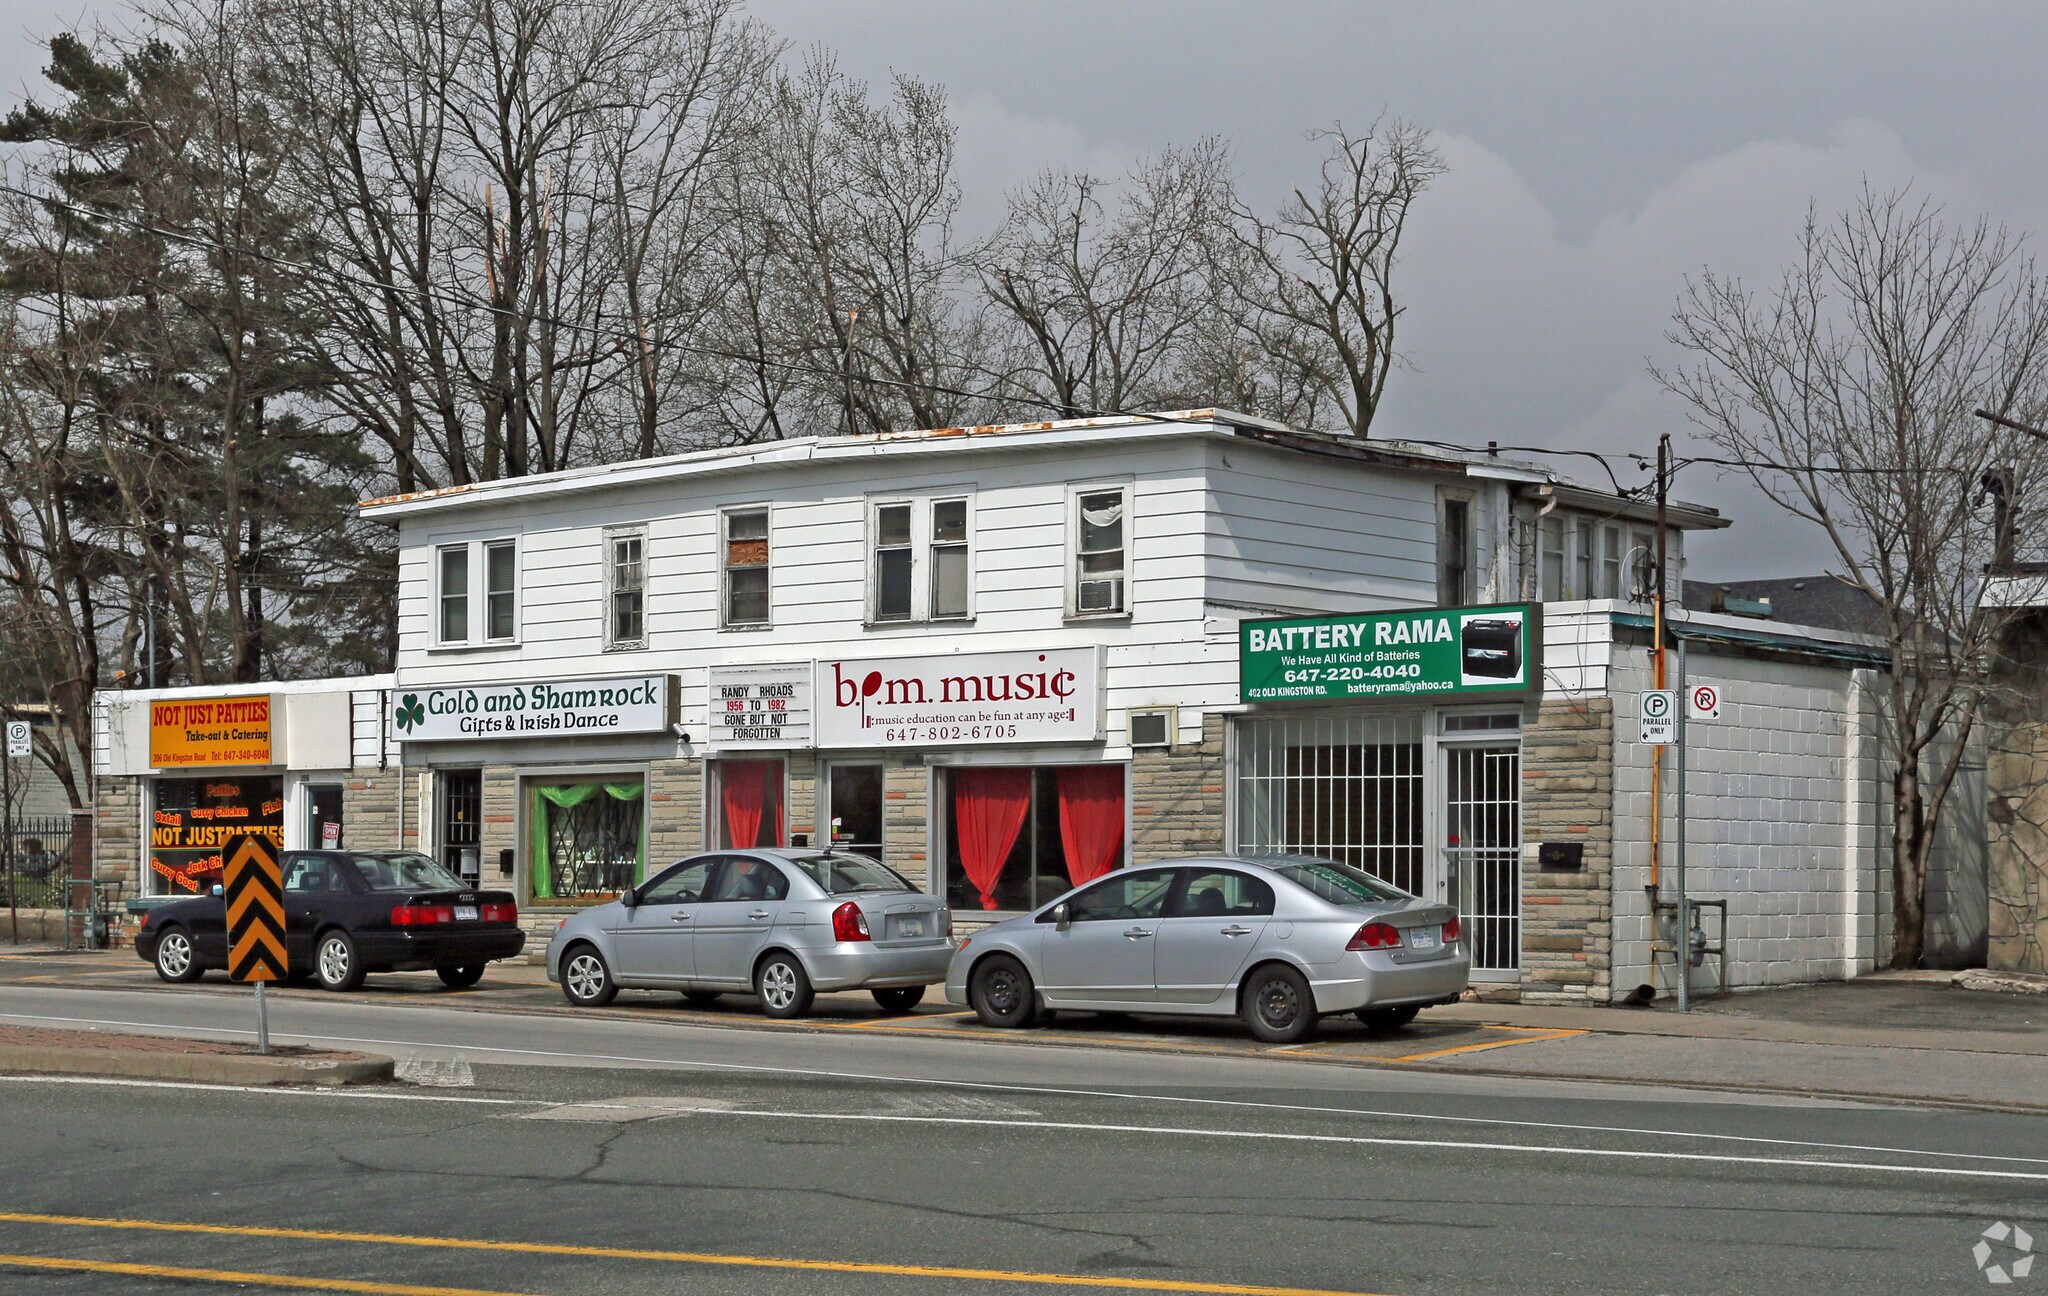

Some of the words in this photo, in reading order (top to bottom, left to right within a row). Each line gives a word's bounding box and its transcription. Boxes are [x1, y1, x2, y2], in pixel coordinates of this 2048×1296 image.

[1250, 623, 1366, 652] BATTERY
[1375, 618, 1453, 645] RAMA
[1281, 656, 1295, 665] We
[1298, 655, 1321, 665] Have
[1324, 654, 1336, 663] All
[1339, 652, 1361, 663] Kind
[1364, 651, 1374, 662] of
[1377, 650, 1420, 661] Batteries
[1284, 664, 1420, 683] 647-220-4040
[721, 686, 749, 698] RANDY
[760, 685, 794, 697] RHOADS
[1248, 688, 1261, 697] 402
[1262, 687, 1276, 697] OLD
[1277, 686, 1314, 696] KINGSTON
[1315, 685, 1328, 695] RD.
[1347, 680, 1454, 695] batteryrama@yahoo.ca
[428, 689, 479, 715] Gold
[484, 687, 526, 712] and
[726, 700, 744, 711] 1956
[750, 700, 760, 710] TO
[767, 699, 786, 710] 1982
[153, 705, 181, 727] NOT
[183, 703, 213, 730] JUST
[216, 701, 268, 724] PATTIES
[724, 714, 746, 725] GONE
[750, 713, 766, 725] BUT
[771, 713, 788, 724] NOT
[906, 713, 956, 724] education
[958, 713, 976, 723] can
[978, 711, 991, 721] be
[994, 710, 1013, 720] fun
[1013, 711, 1023, 720] at
[1026, 712, 1045, 722] any
[460, 715, 502, 736] Gifts
[505, 714, 516, 731] &
[519, 713, 560, 731] Irish
[564, 712, 619, 729] Dance
[1650, 727, 1665, 735] ONLY
[186, 730, 221, 741] Take-out
[223, 729, 229, 740] &
[231, 728, 268, 742] Catering
[733, 727, 781, 739] FORGOTTEN
[886, 724, 1016, 741] 647-802-6705
[163, 753, 172, 762] Old
[172, 752, 193, 764] Kingston
[194, 752, 206, 761] Road
[211, 751, 222, 761] Tel:
[223, 749, 269, 761] 647-340-6040
[207, 784, 240, 796] Patties
[191, 807, 215, 820] Curry
[215, 806, 249, 817] Chicken
[262, 798, 283, 816] Fish
[154, 810, 182, 826] Oxtail
[152, 826, 182, 846] NOT
[186, 826, 225, 845] JUST
[324, 827, 337, 835] OPEN
[186, 858, 208, 875] Jerk
[151, 857, 176, 881] Curry
[175, 871, 199, 893] Goat
